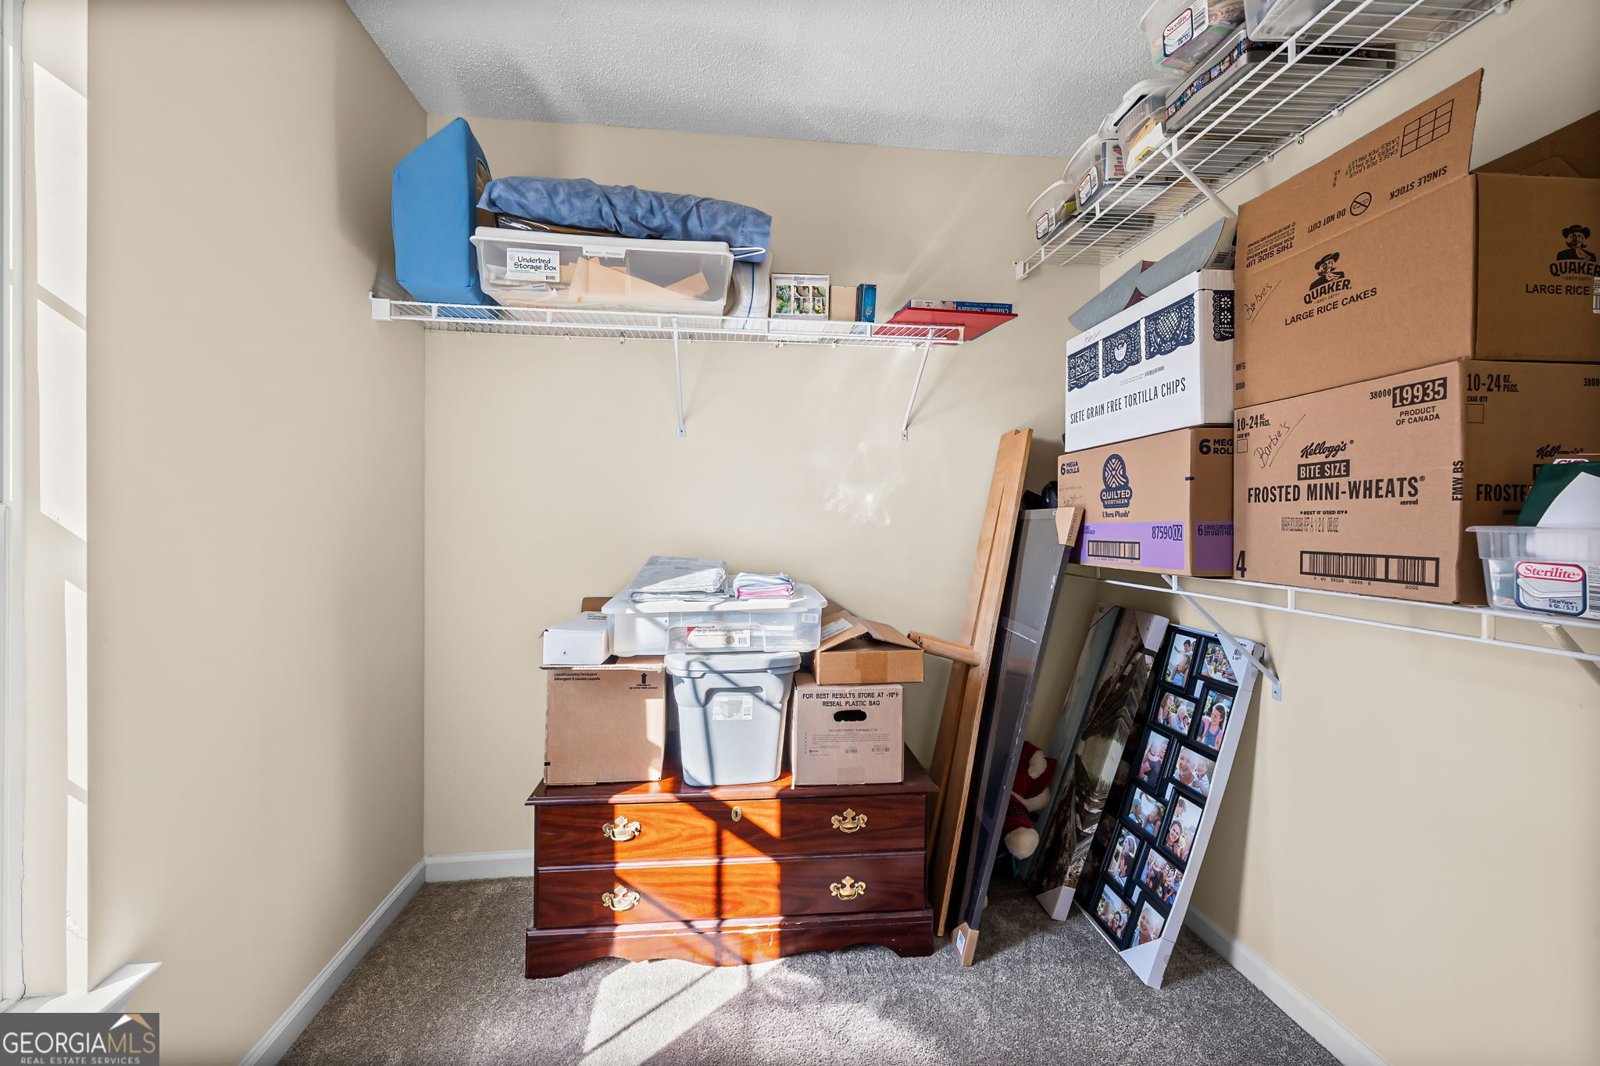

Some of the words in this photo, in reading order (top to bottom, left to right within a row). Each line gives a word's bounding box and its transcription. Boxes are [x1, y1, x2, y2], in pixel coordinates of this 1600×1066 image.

[1416, 165, 1448, 188] SINGLE
[1389, 180, 1415, 200] STOCK
[1322, 216, 1336, 227] NOT
[1336, 208, 1346, 220] DO
[1307, 222, 1322, 234] CUT!
[1276, 241, 1294, 256] THIS
[518, 256, 550, 264] Underbed
[1246, 258, 1256, 268] UP
[1258, 250, 1275, 264] SIDE
[514, 262, 542, 272] Storage
[1550, 261, 1600, 278] QUAKER
[1304, 278, 1351, 305] QUAKER
[1525, 284, 1562, 295] LARGE
[1565, 285, 1590, 296] RICE
[1284, 308, 1314, 326] LARGE
[1316, 301, 1338, 316] RICE
[1341, 287, 1378, 306] CAKES
[1466, 372, 1501, 392] 10-24
[1369, 388, 1392, 400] 38000
[1394, 379, 1445, 406] 19935
[1070, 409, 1084, 425] SIETE
[1086, 402, 1104, 420] GRAIN
[1106, 397, 1122, 414] FREE
[1124, 386, 1158, 408] TORTILLA
[1160, 377, 1186, 398] CHIPS
[1396, 418, 1406, 426] OF
[1408, 413, 1440, 424] CANADA
[1400, 406, 1436, 418] PRODUCT
[1236, 414, 1258, 432] 10-24
[1199, 438, 1212, 455] 6
[1300, 440, 1347, 458] Kellogg's
[1060, 463, 1066, 476] 6
[1300, 464, 1321, 478] BITE
[1324, 462, 1347, 476] SIZE
[1452, 460, 1464, 473] BS
[1102, 489, 1131, 500] QUILTED
[1248, 484, 1300, 504] FROSTED
[1452, 476, 1464, 501] FMW
[1476, 484, 1531, 502] FROSTE
[1400, 498, 1418, 506] cereal
[1198, 524, 1204, 536] 6
[1236, 550, 1247, 578] 4
[1524, 564, 1576, 580] Sterilite
